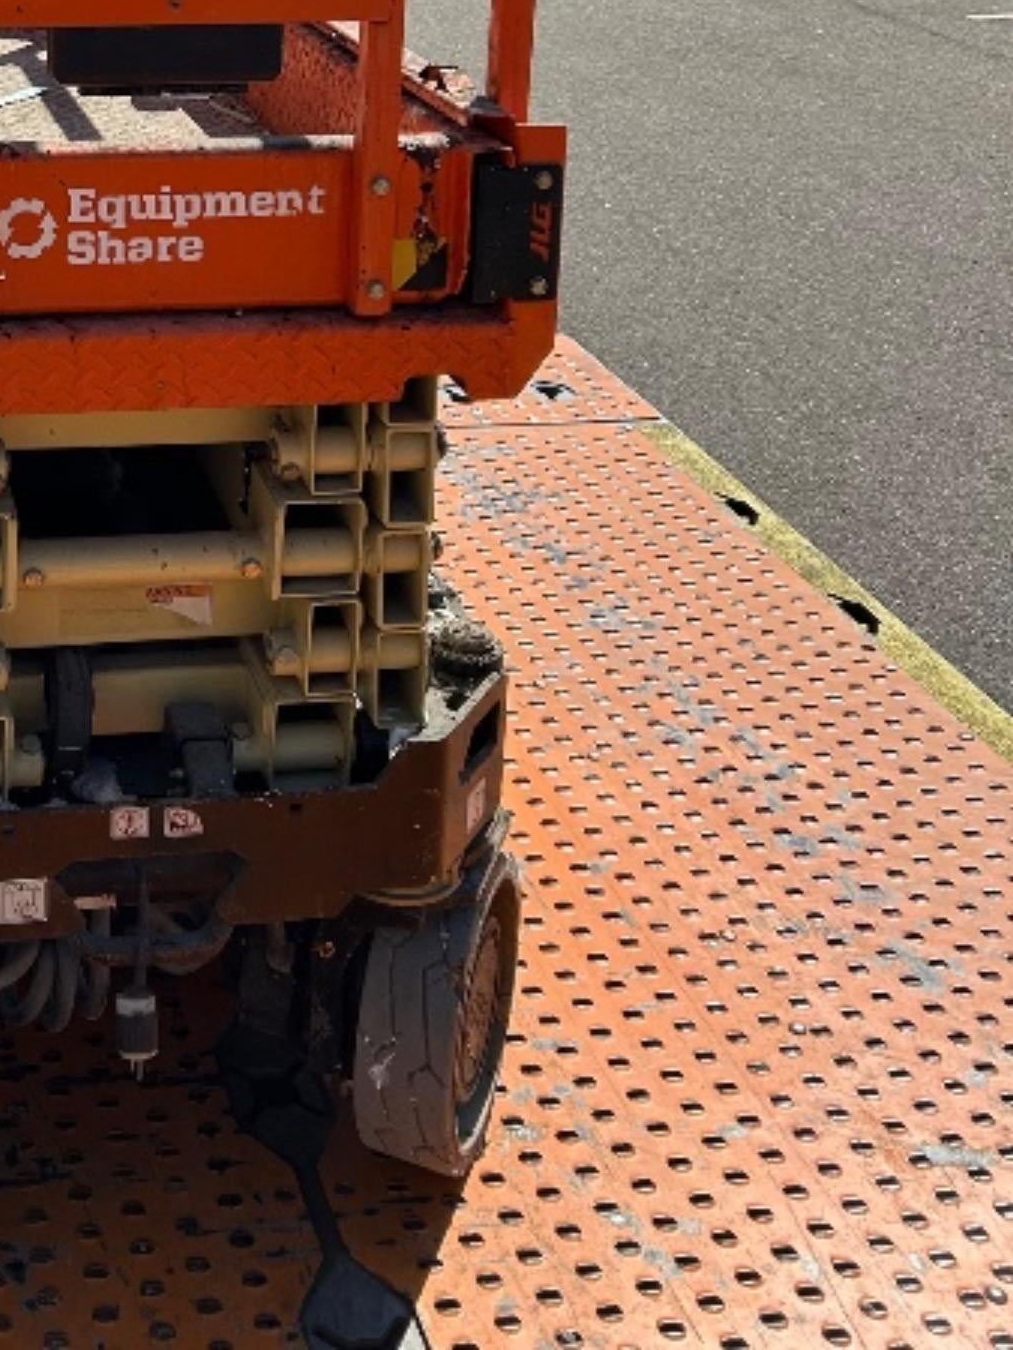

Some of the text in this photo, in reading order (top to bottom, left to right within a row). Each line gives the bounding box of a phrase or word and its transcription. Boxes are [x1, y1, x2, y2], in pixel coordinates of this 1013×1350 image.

[67, 185, 326, 229] Equipment
[67, 230, 204, 265] Share
[529, 201, 553, 262] JLG
